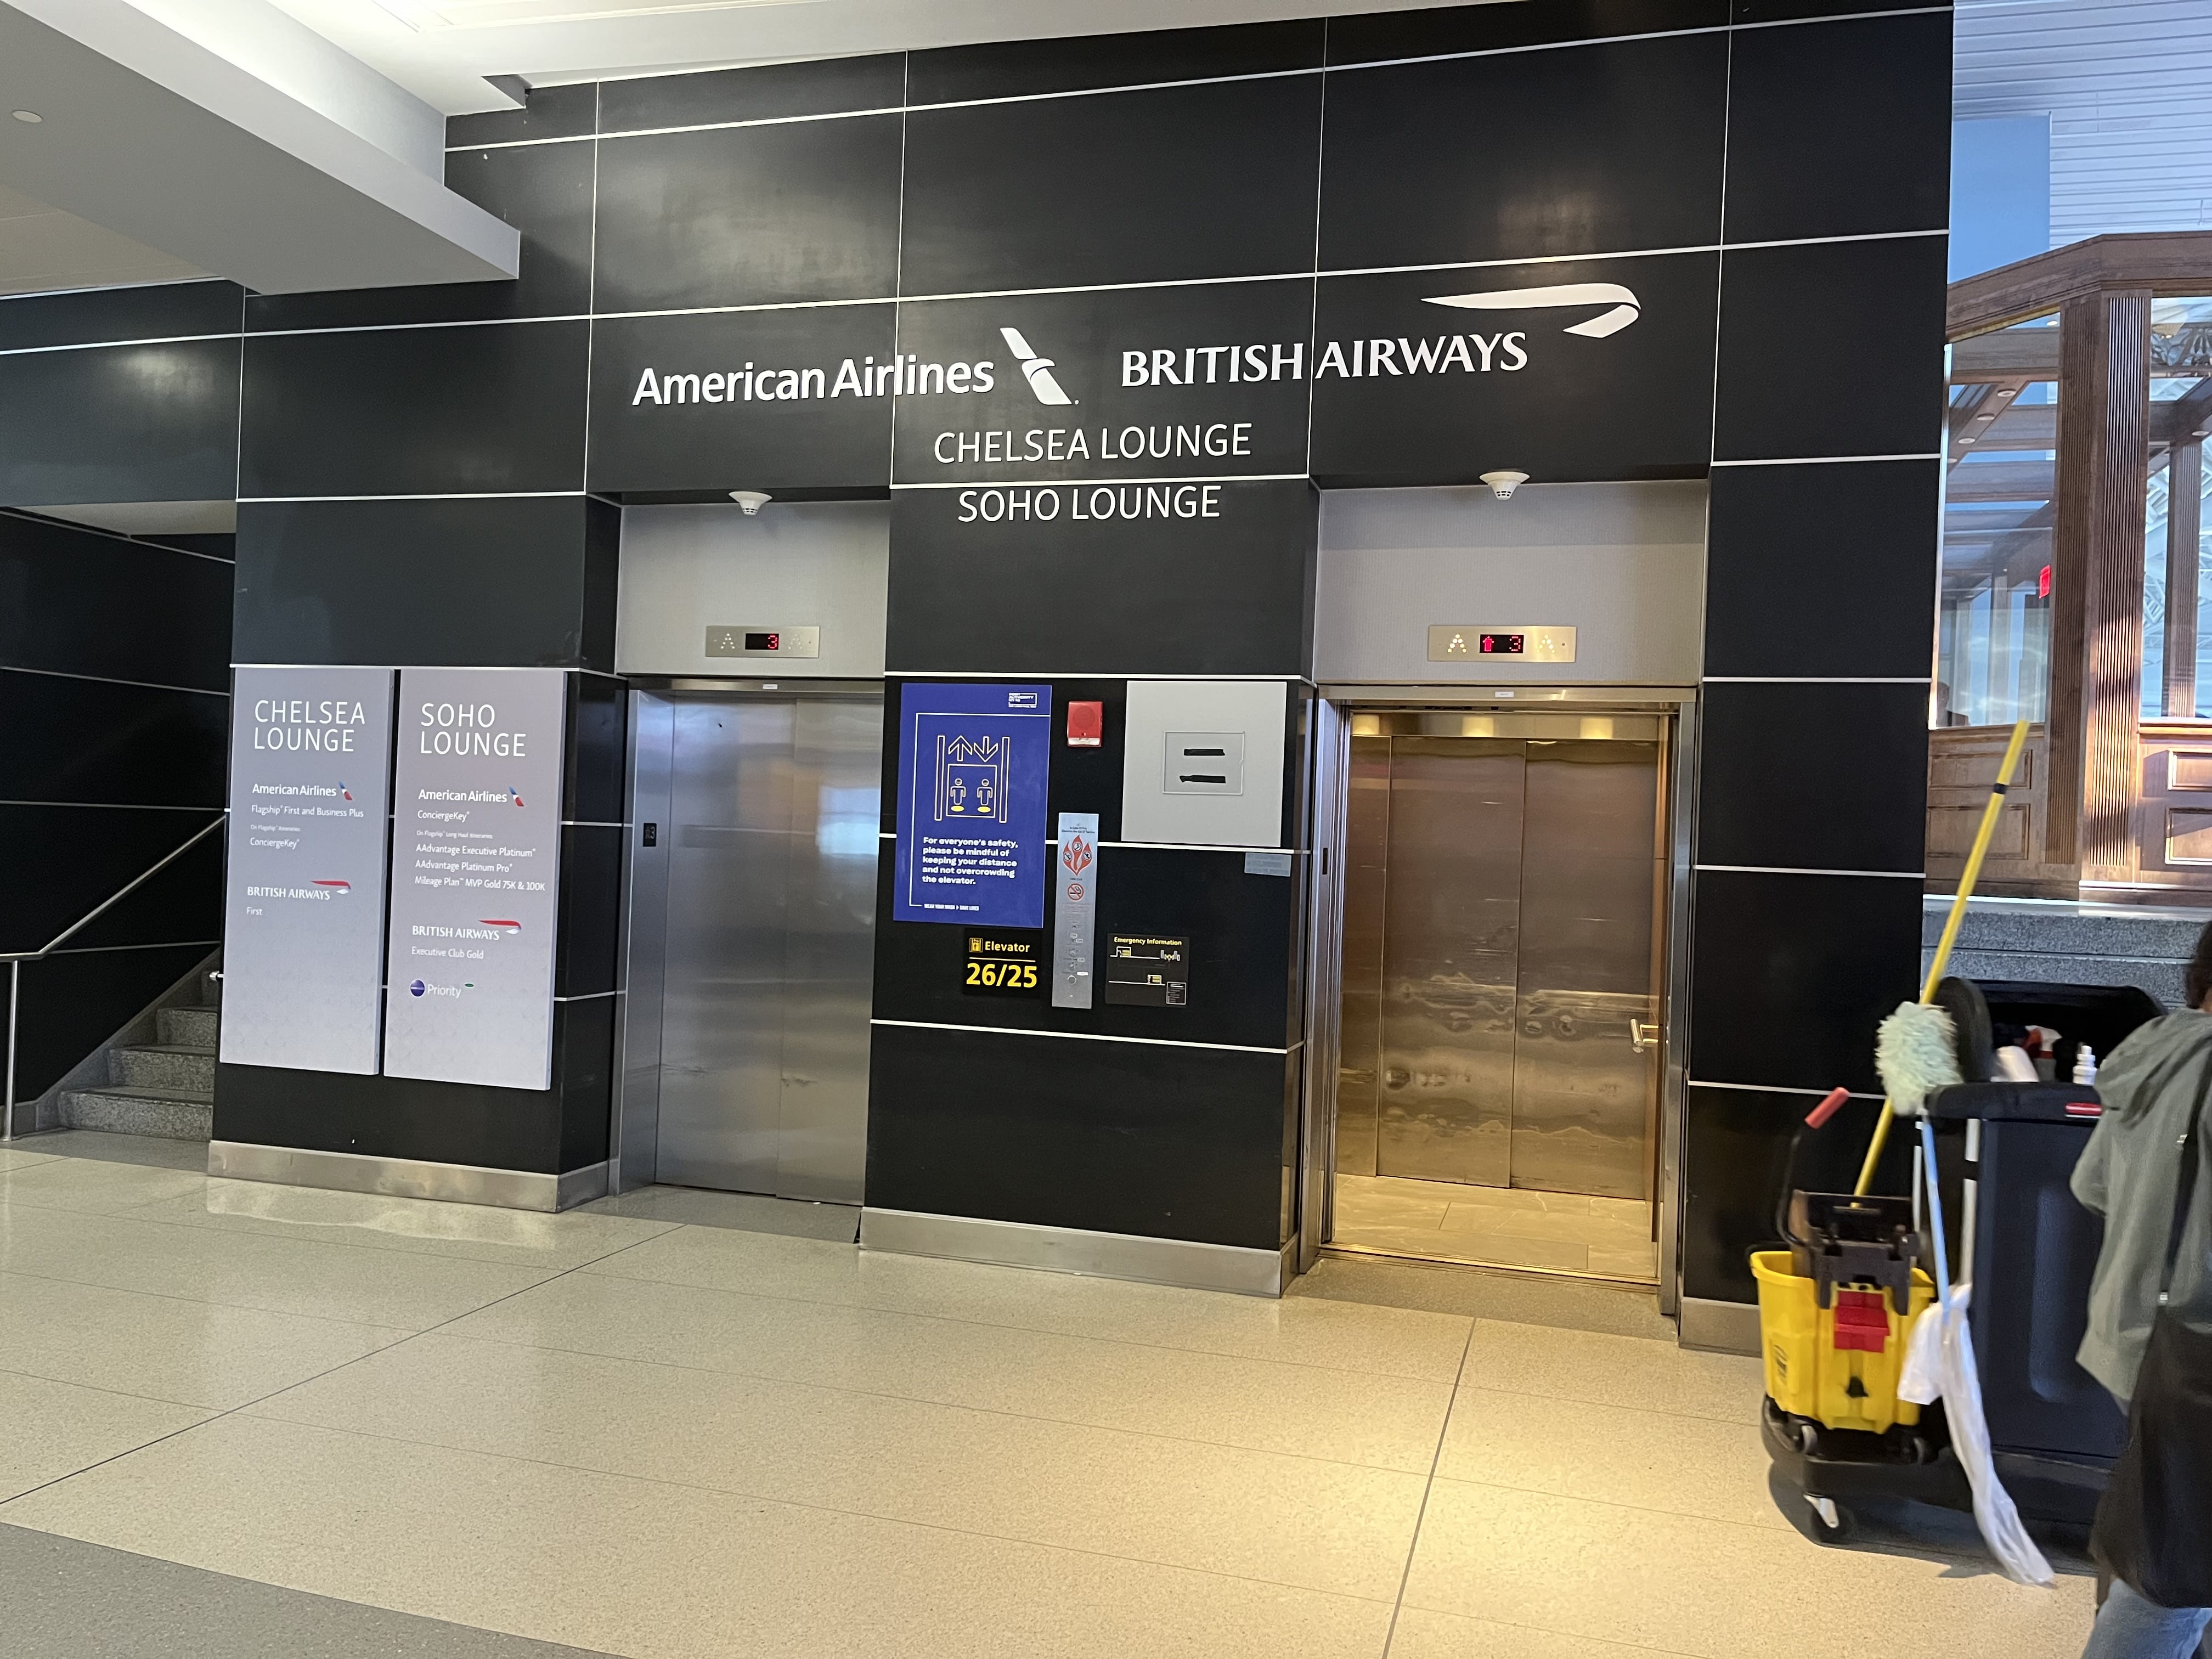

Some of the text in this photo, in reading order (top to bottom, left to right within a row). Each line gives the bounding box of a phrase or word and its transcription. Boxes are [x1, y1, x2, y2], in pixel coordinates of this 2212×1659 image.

[1121, 332, 1527, 386] BRITISH AIRWAYS
[633, 354, 994, 405] American Airlines
[934, 424, 1252, 464] CHELSEA LOUNGE
[958, 485, 1221, 522] SOHO LOUNGE
[768, 635, 778, 649] 3
[1509, 636, 1521, 652] 3
[255, 700, 365, 725] CHELSEA
[421, 703, 495, 728] SOHO
[255, 727, 354, 752] LOUNGE
[421, 731, 527, 757] LOUNGE
[252, 783, 337, 797] American Airlines
[418, 789, 507, 803] American Airlines
[284, 806, 300, 815] First
[302, 806, 315, 815] and
[317, 808, 347, 816] Business
[349, 808, 364, 817] Plus
[416, 843, 460, 856] AAdvantage
[462, 845, 497, 856] Executive
[923, 837, 1018, 849] For everyone's safety,
[923, 847, 951, 855] please
[966, 848, 998, 856] mindful
[415, 860, 459, 872] AAdvantage
[461, 862, 494, 872] Platinum
[922, 856, 1017, 867] keeping your distance
[956, 867, 1015, 878] overcrowding
[415, 876, 442, 888] Mileage
[465, 878, 482, 887] MVP
[484, 879, 501, 889] Gold
[503, 880, 516, 889] 75K
[517, 881, 524, 890] &
[526, 882, 546, 891] 100K
[938, 876, 976, 885] elevator.
[247, 886, 330, 900] BRITISH AIRWAYS
[246, 907, 262, 916] First
[412, 926, 500, 940] BRITISH AIRWAYS
[985, 940, 1030, 952] Elevator
[1114, 936, 1146, 945] Emergency
[411, 946, 484, 959] Executive Club Gold
[966, 962, 1037, 988] 26/25
[427, 984, 461, 998] Priority
